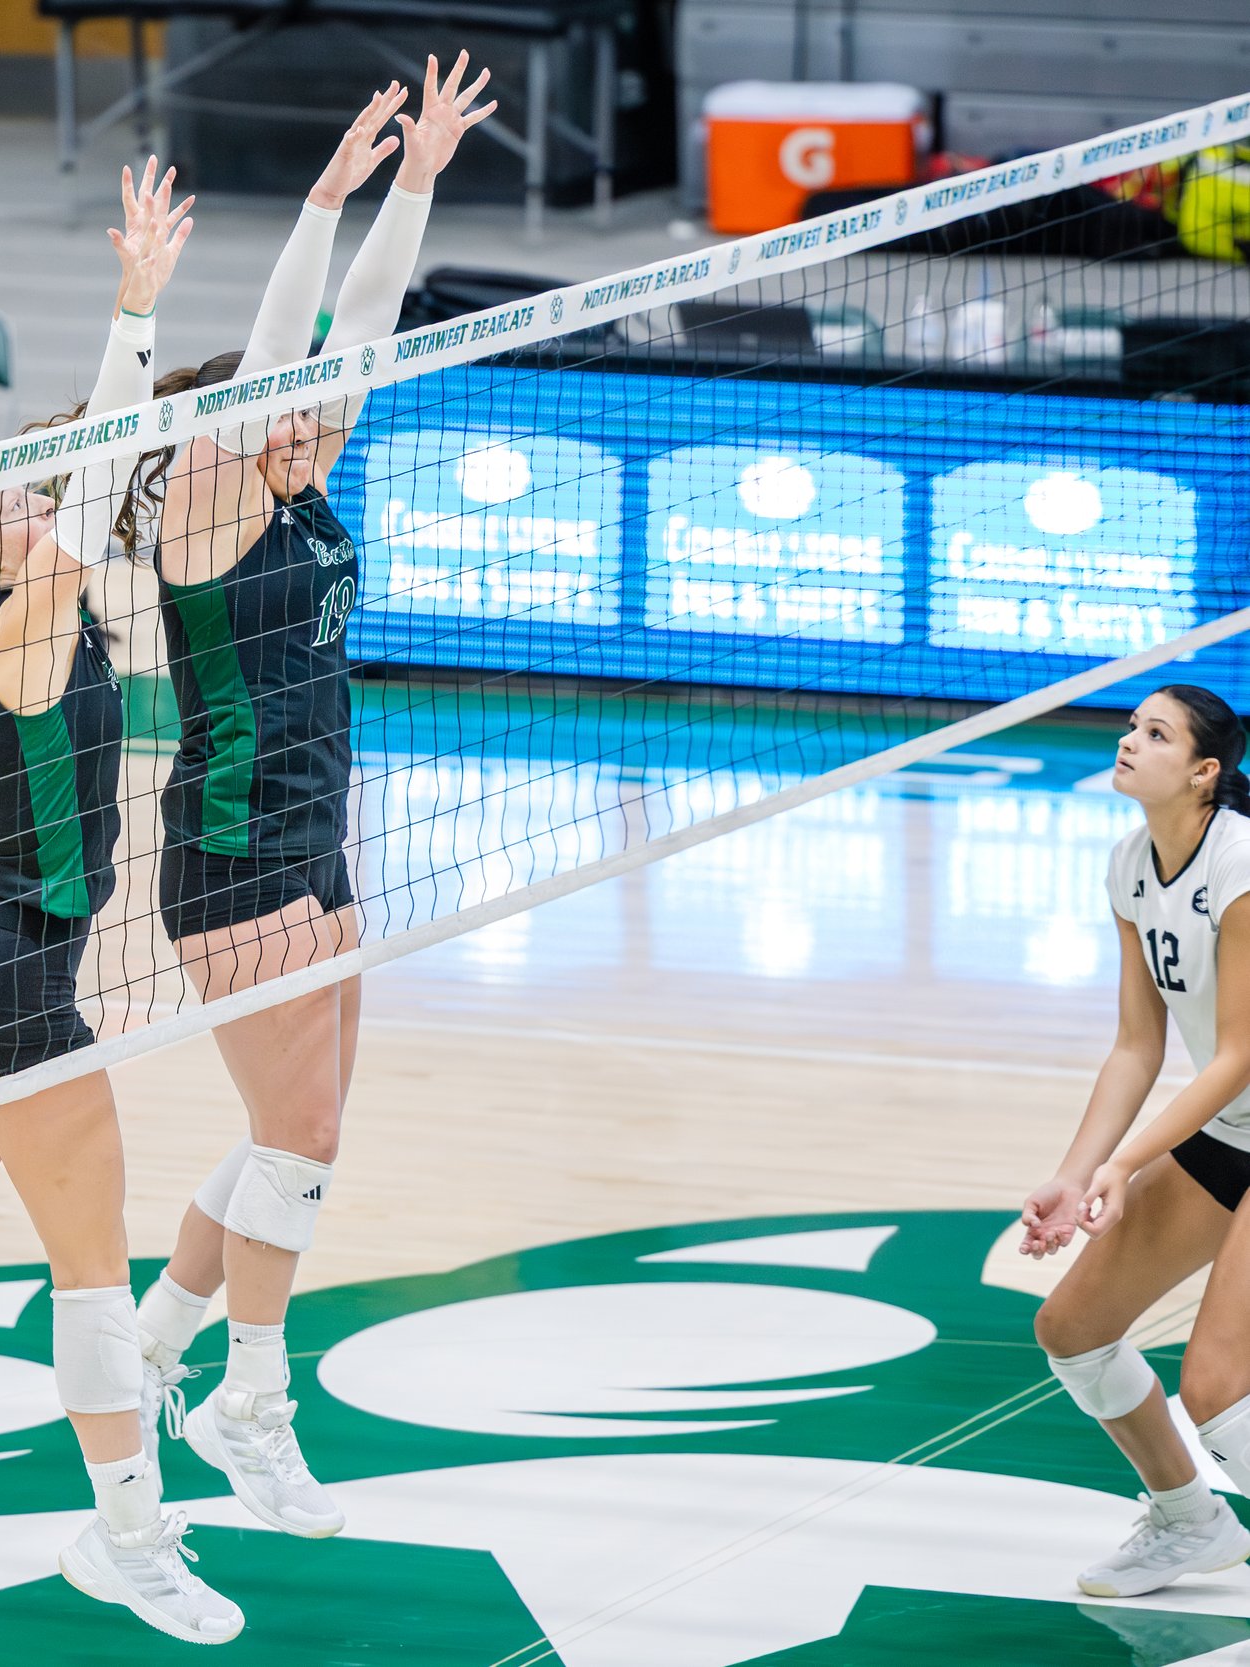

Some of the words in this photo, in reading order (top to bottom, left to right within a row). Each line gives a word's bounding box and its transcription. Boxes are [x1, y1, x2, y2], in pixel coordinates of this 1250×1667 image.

[780, 128, 837, 189] G
[756, 226, 823, 262] NORTHWEST
[826, 209, 882, 244] BEARCATS
[580, 273, 654, 312] NORTHWEST
[654, 256, 712, 291] BEARCATS
[394, 323, 469, 363] NORTHWEST
[469, 306, 535, 342] BEARCATS
[194, 375, 275, 418] NORTHWEST
[276, 357, 343, 395] BEARCATS
[65, 412, 139, 453] BEARCATS
[311, 575, 355, 647] 19
[1146, 928, 1187, 992] 12
